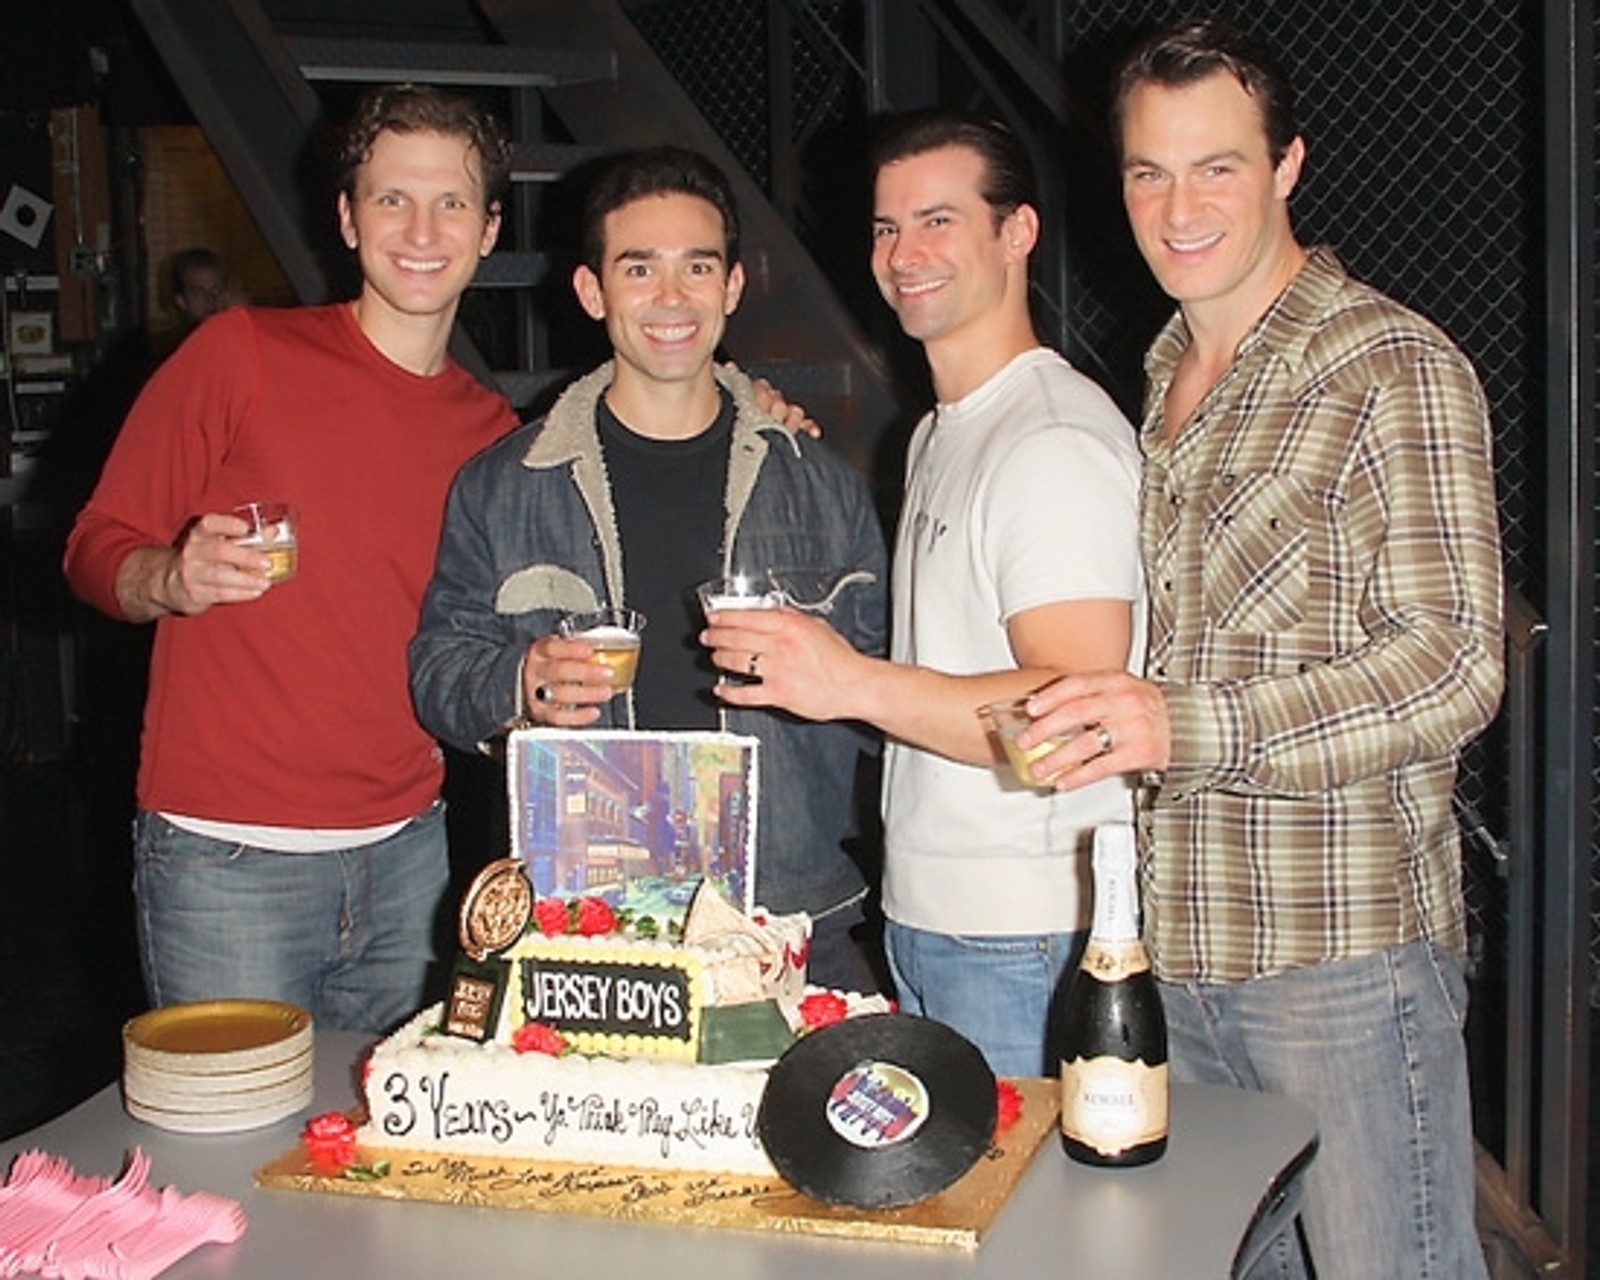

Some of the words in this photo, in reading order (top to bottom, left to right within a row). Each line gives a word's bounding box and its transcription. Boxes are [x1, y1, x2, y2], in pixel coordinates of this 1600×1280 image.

[525, 971, 612, 1021] JERSEY
[616, 978, 682, 1029] BOYS
[383, 1072, 417, 1137] 3
